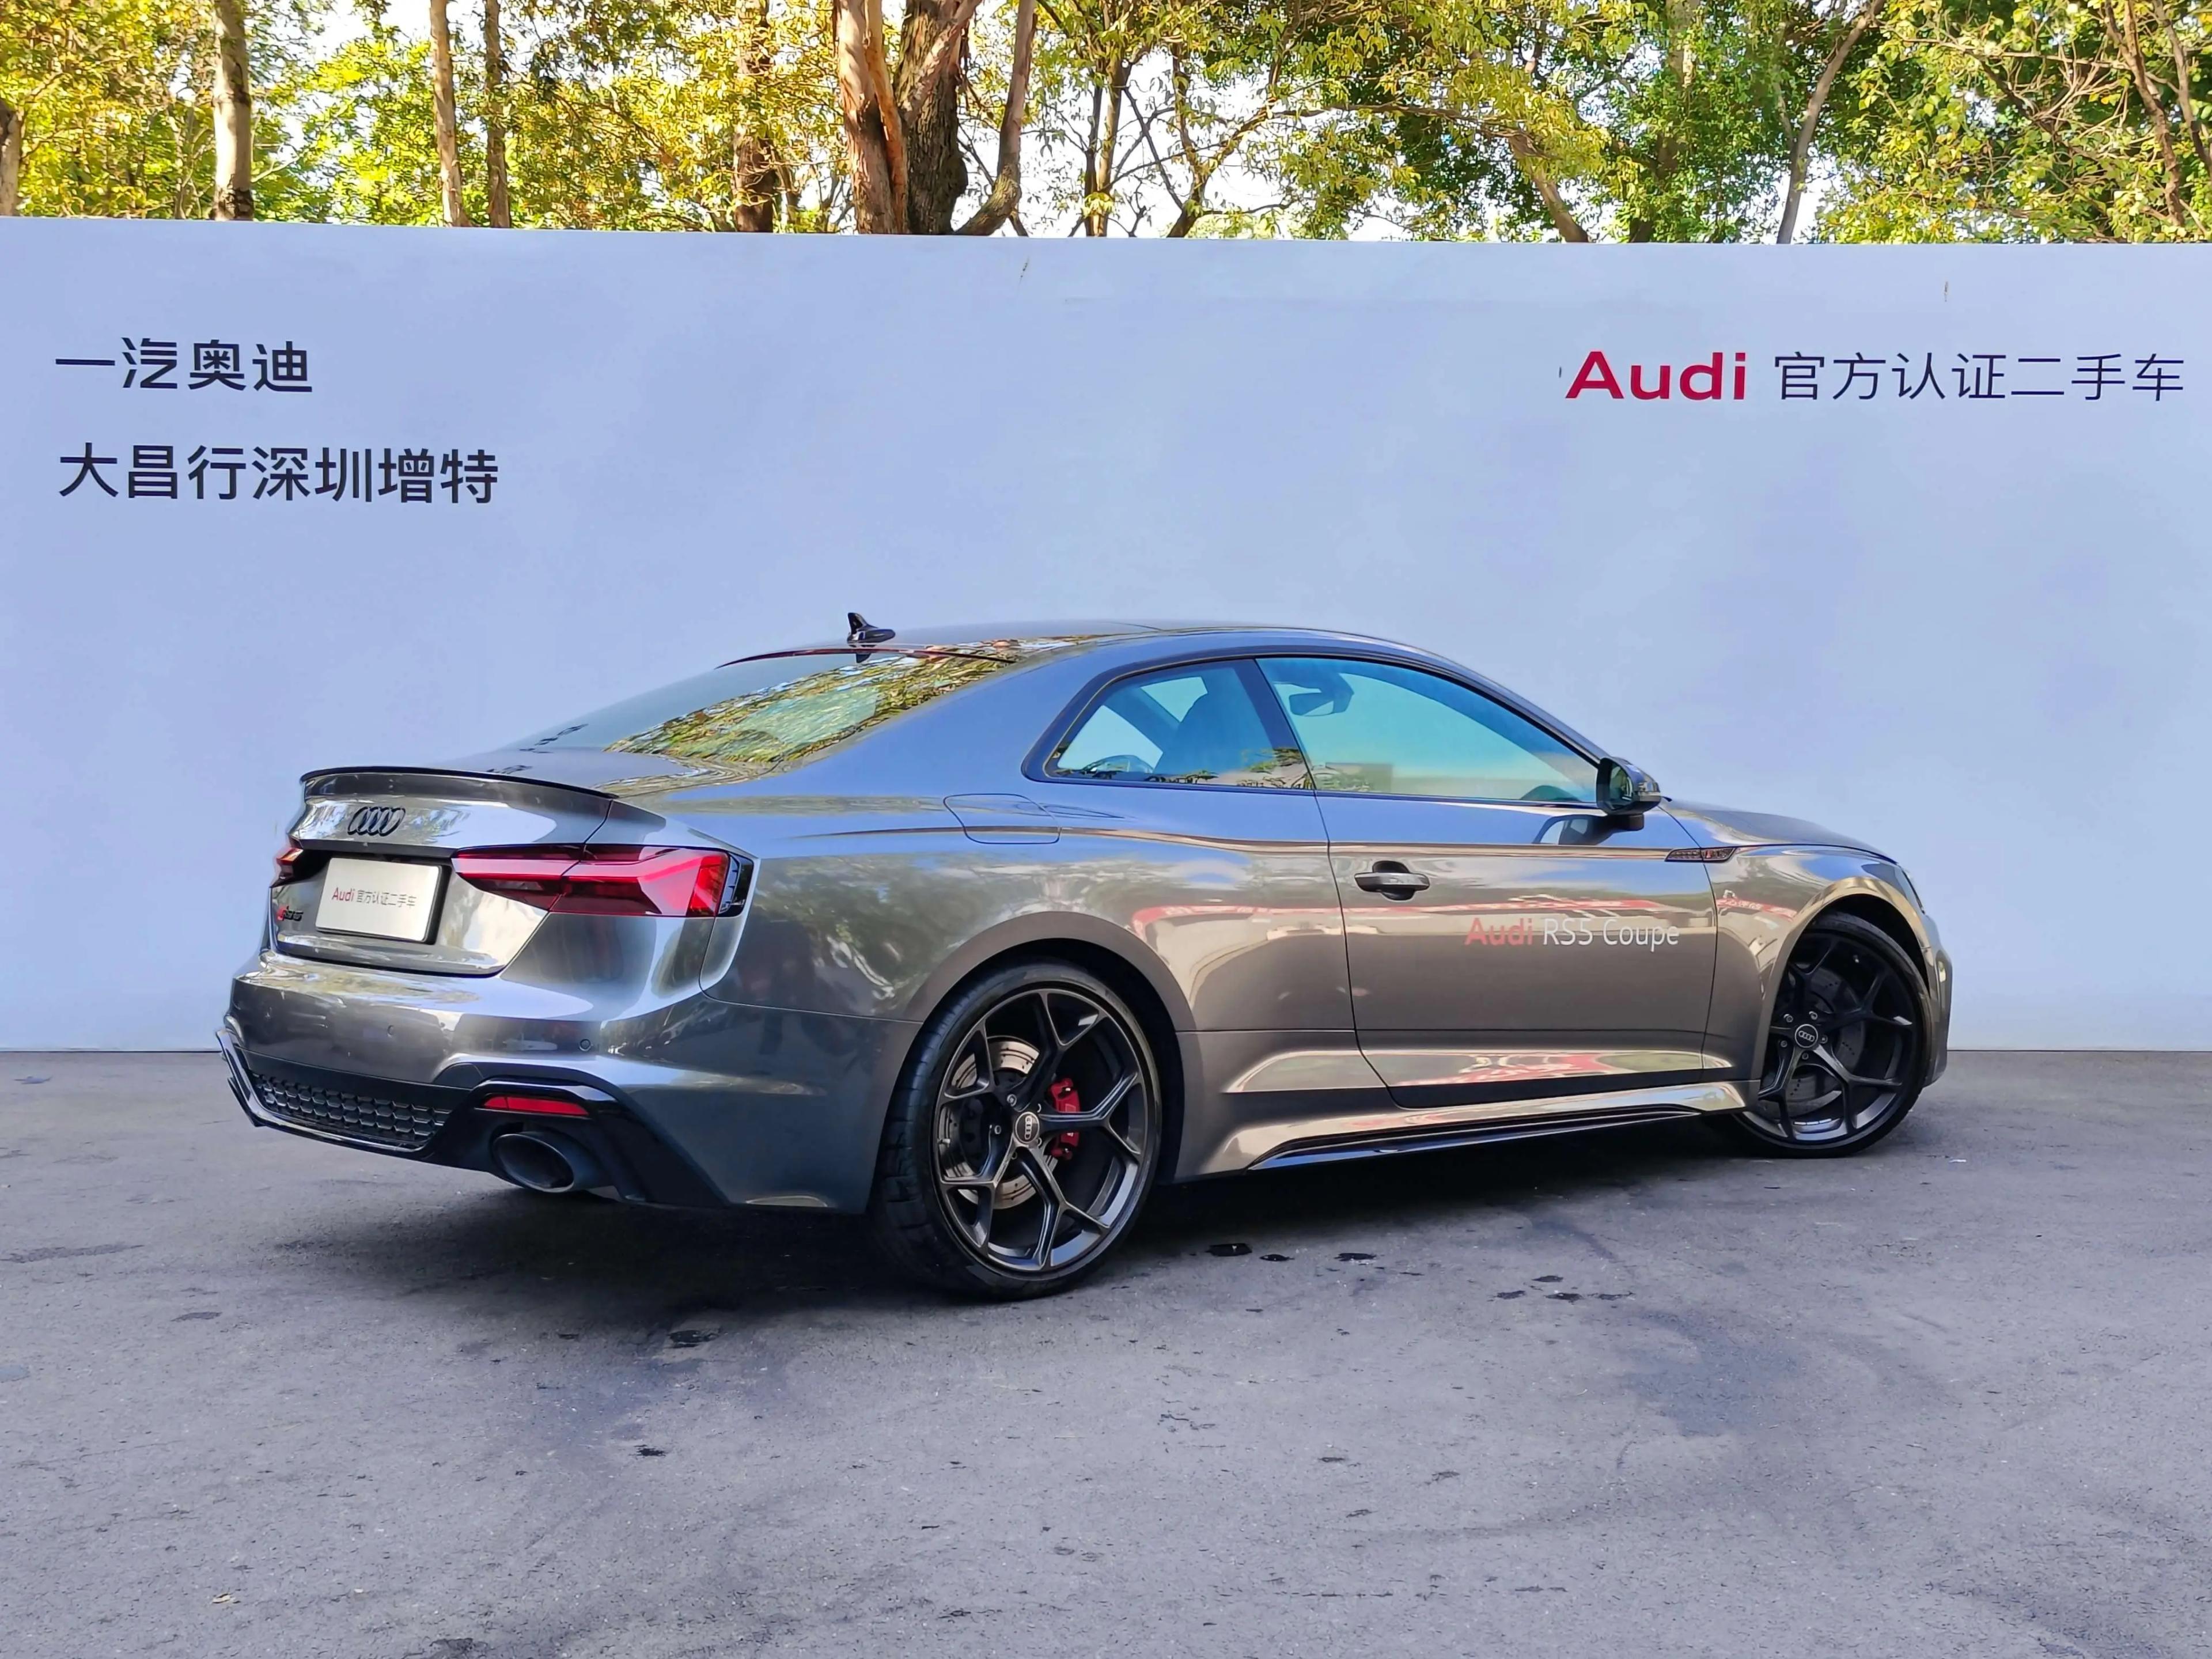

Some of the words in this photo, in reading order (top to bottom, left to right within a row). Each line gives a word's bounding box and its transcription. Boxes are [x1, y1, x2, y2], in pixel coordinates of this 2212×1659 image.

[55, 337, 312, 392] 一汽奥迪
[1566, 350, 1747, 401] Audi
[1774, 351, 2184, 402] 官方认证二手车
[59, 442, 498, 503] 大昌行深圳增特
[332, 887, 355, 902] Audi
[1464, 918, 1533, 946] Audi
[1543, 918, 1594, 946] RS5
[1603, 918, 1680, 952] Coupe
